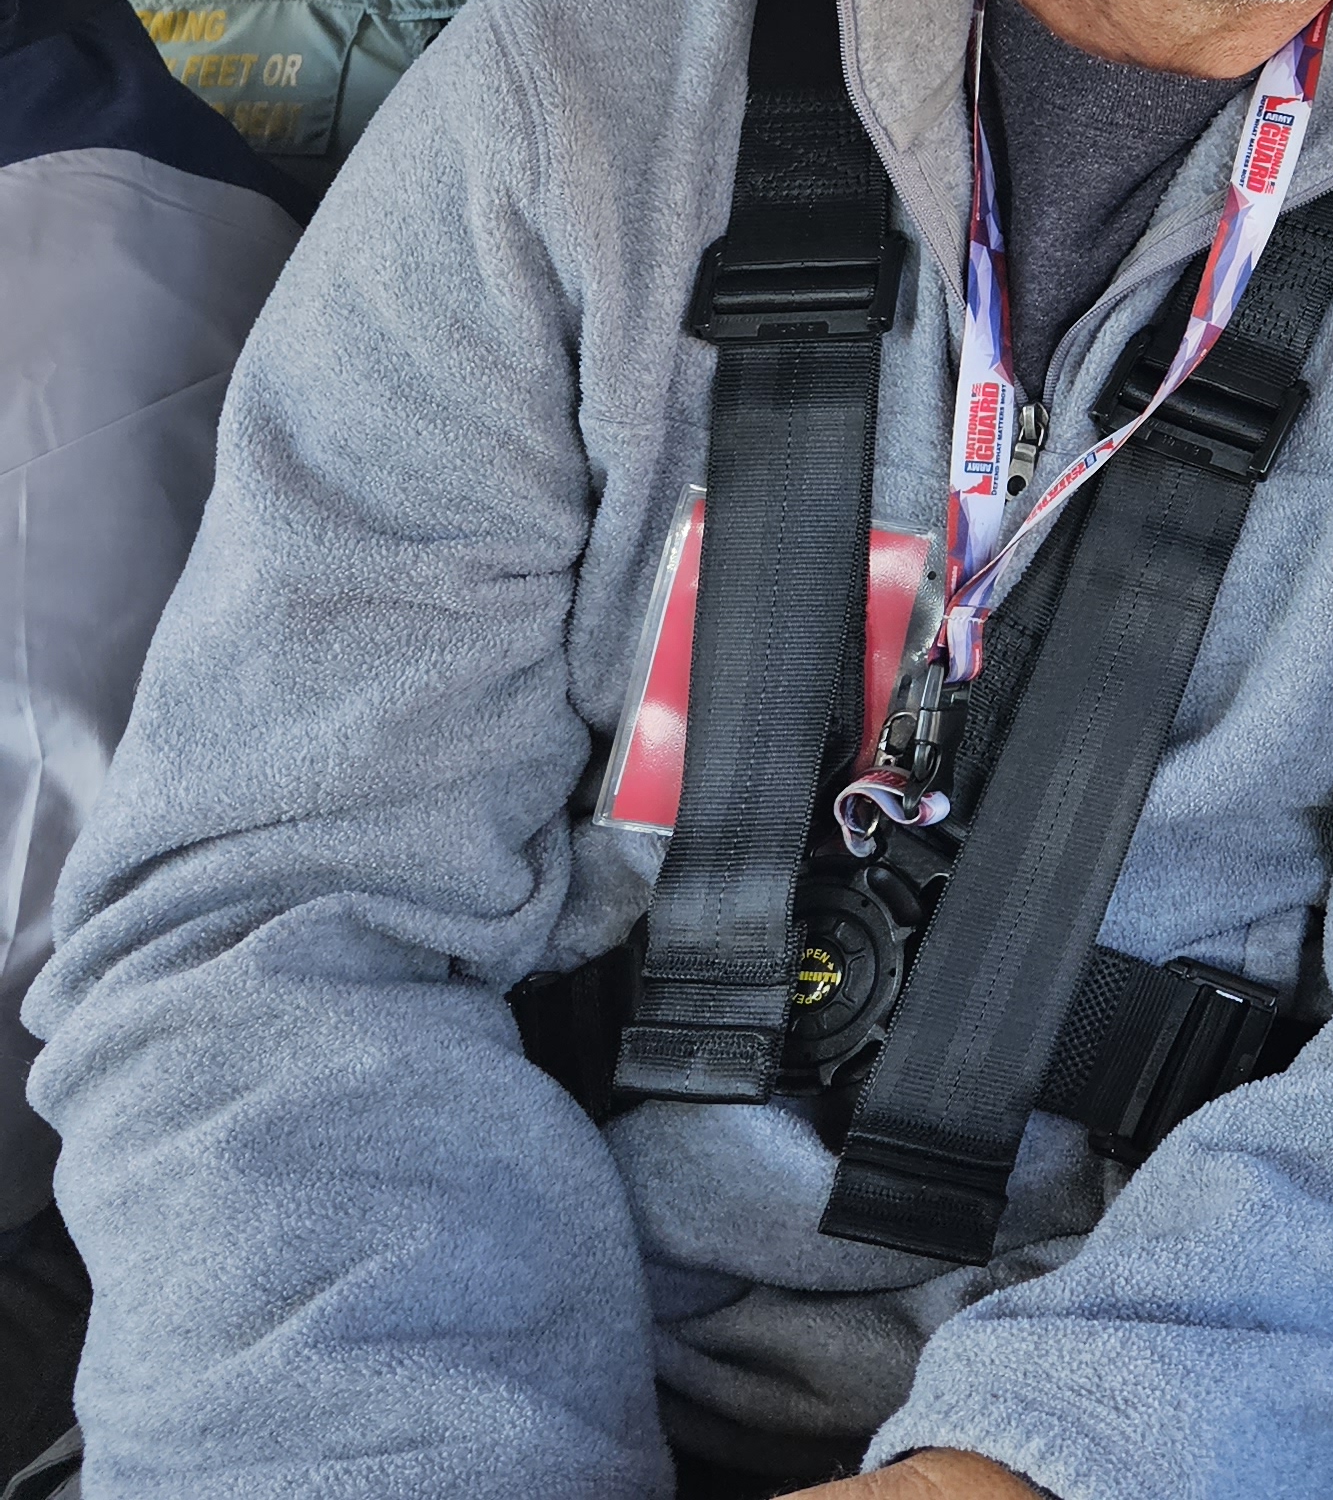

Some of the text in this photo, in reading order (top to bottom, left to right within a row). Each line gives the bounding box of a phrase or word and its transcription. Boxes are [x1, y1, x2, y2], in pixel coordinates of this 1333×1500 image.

[136, 9, 227, 43] NING
[181, 53, 259, 89] FEET
[262, 52, 303, 88] OR
[1238, 95, 1269, 188] DEFEND WHAT MATTERS MOST
[1263, 112, 1294, 125] ARMY
[1246, 122, 1282, 194] GUARD
[1268, 126, 1293, 180] NATIONAL
[965, 400, 980, 459] NATIONAL
[975, 382, 1000, 461] GUARD
[966, 462, 992, 473] ARMY
[991, 465, 1000, 495] DEFEND
[996, 406, 1005, 440] MATTERS
